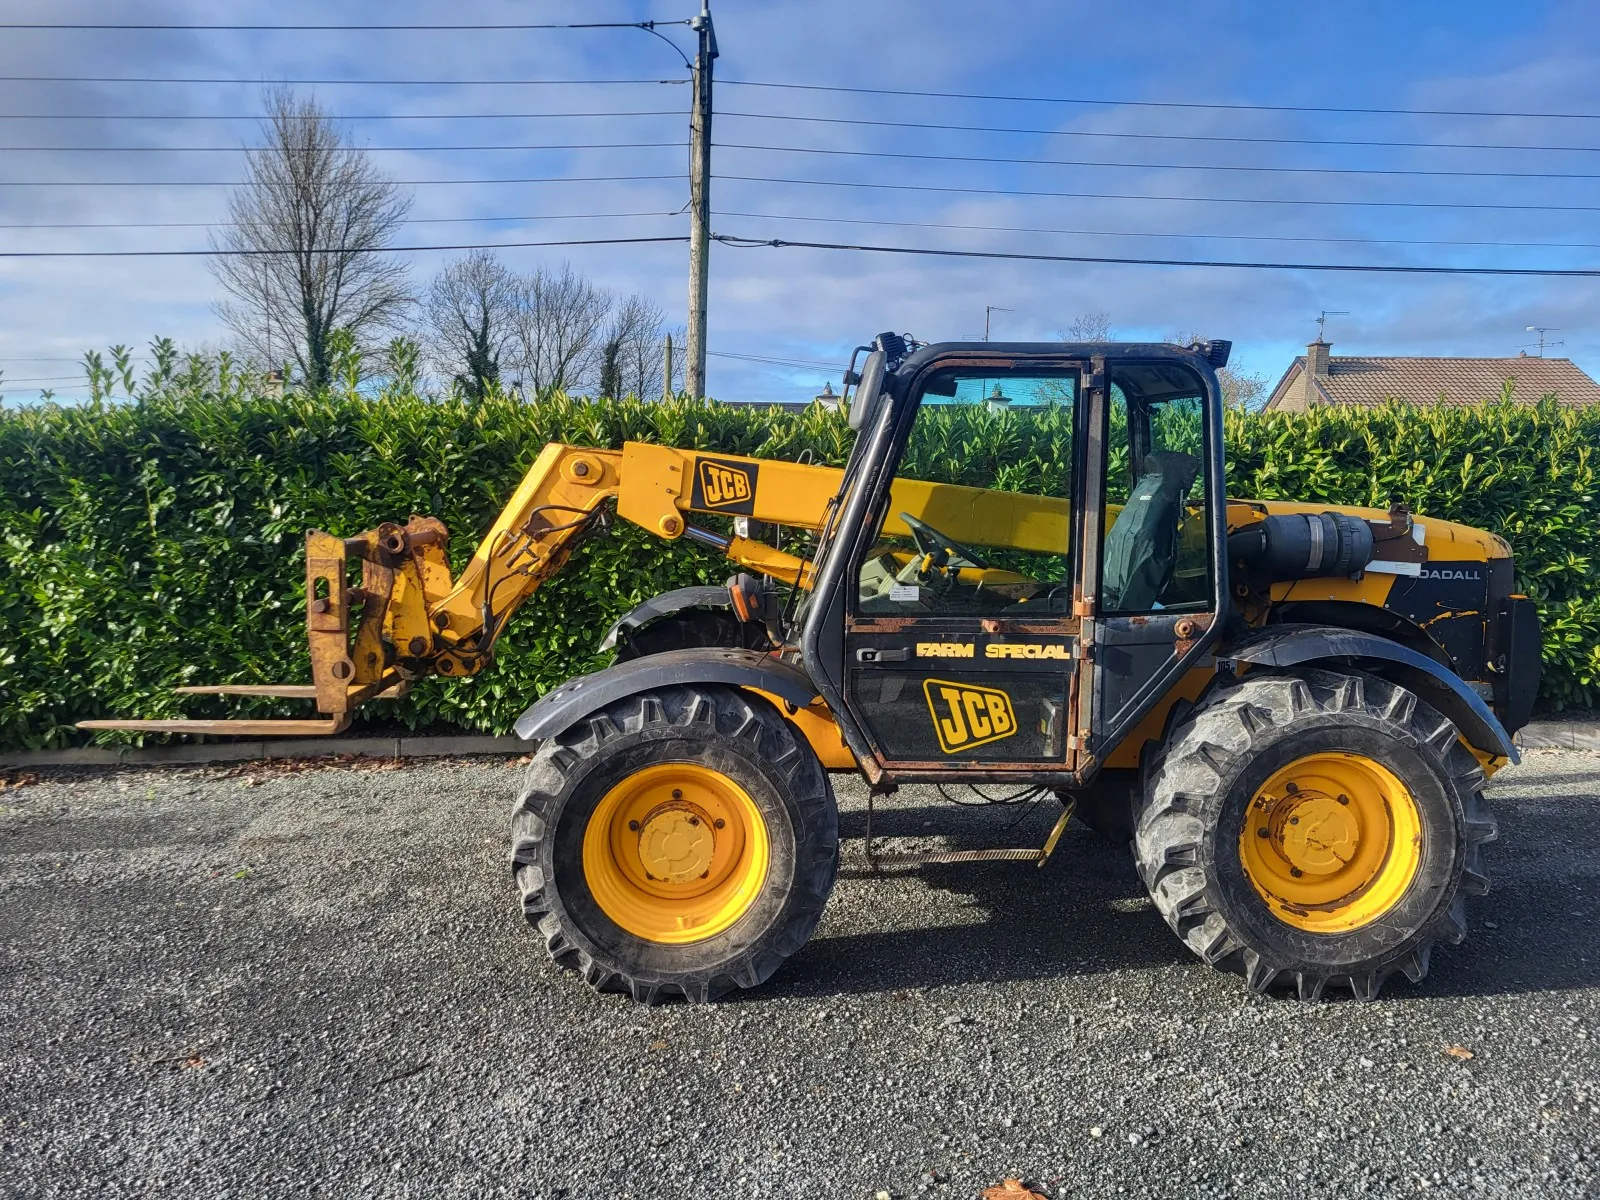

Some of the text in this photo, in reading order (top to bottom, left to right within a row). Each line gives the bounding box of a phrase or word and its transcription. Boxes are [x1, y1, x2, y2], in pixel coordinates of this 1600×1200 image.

[706, 466, 748, 502] JCB
[1409, 569, 1480, 580] OADALL
[916, 642, 1071, 660] FARM SPECIAL
[940, 687, 1011, 745] JCB
